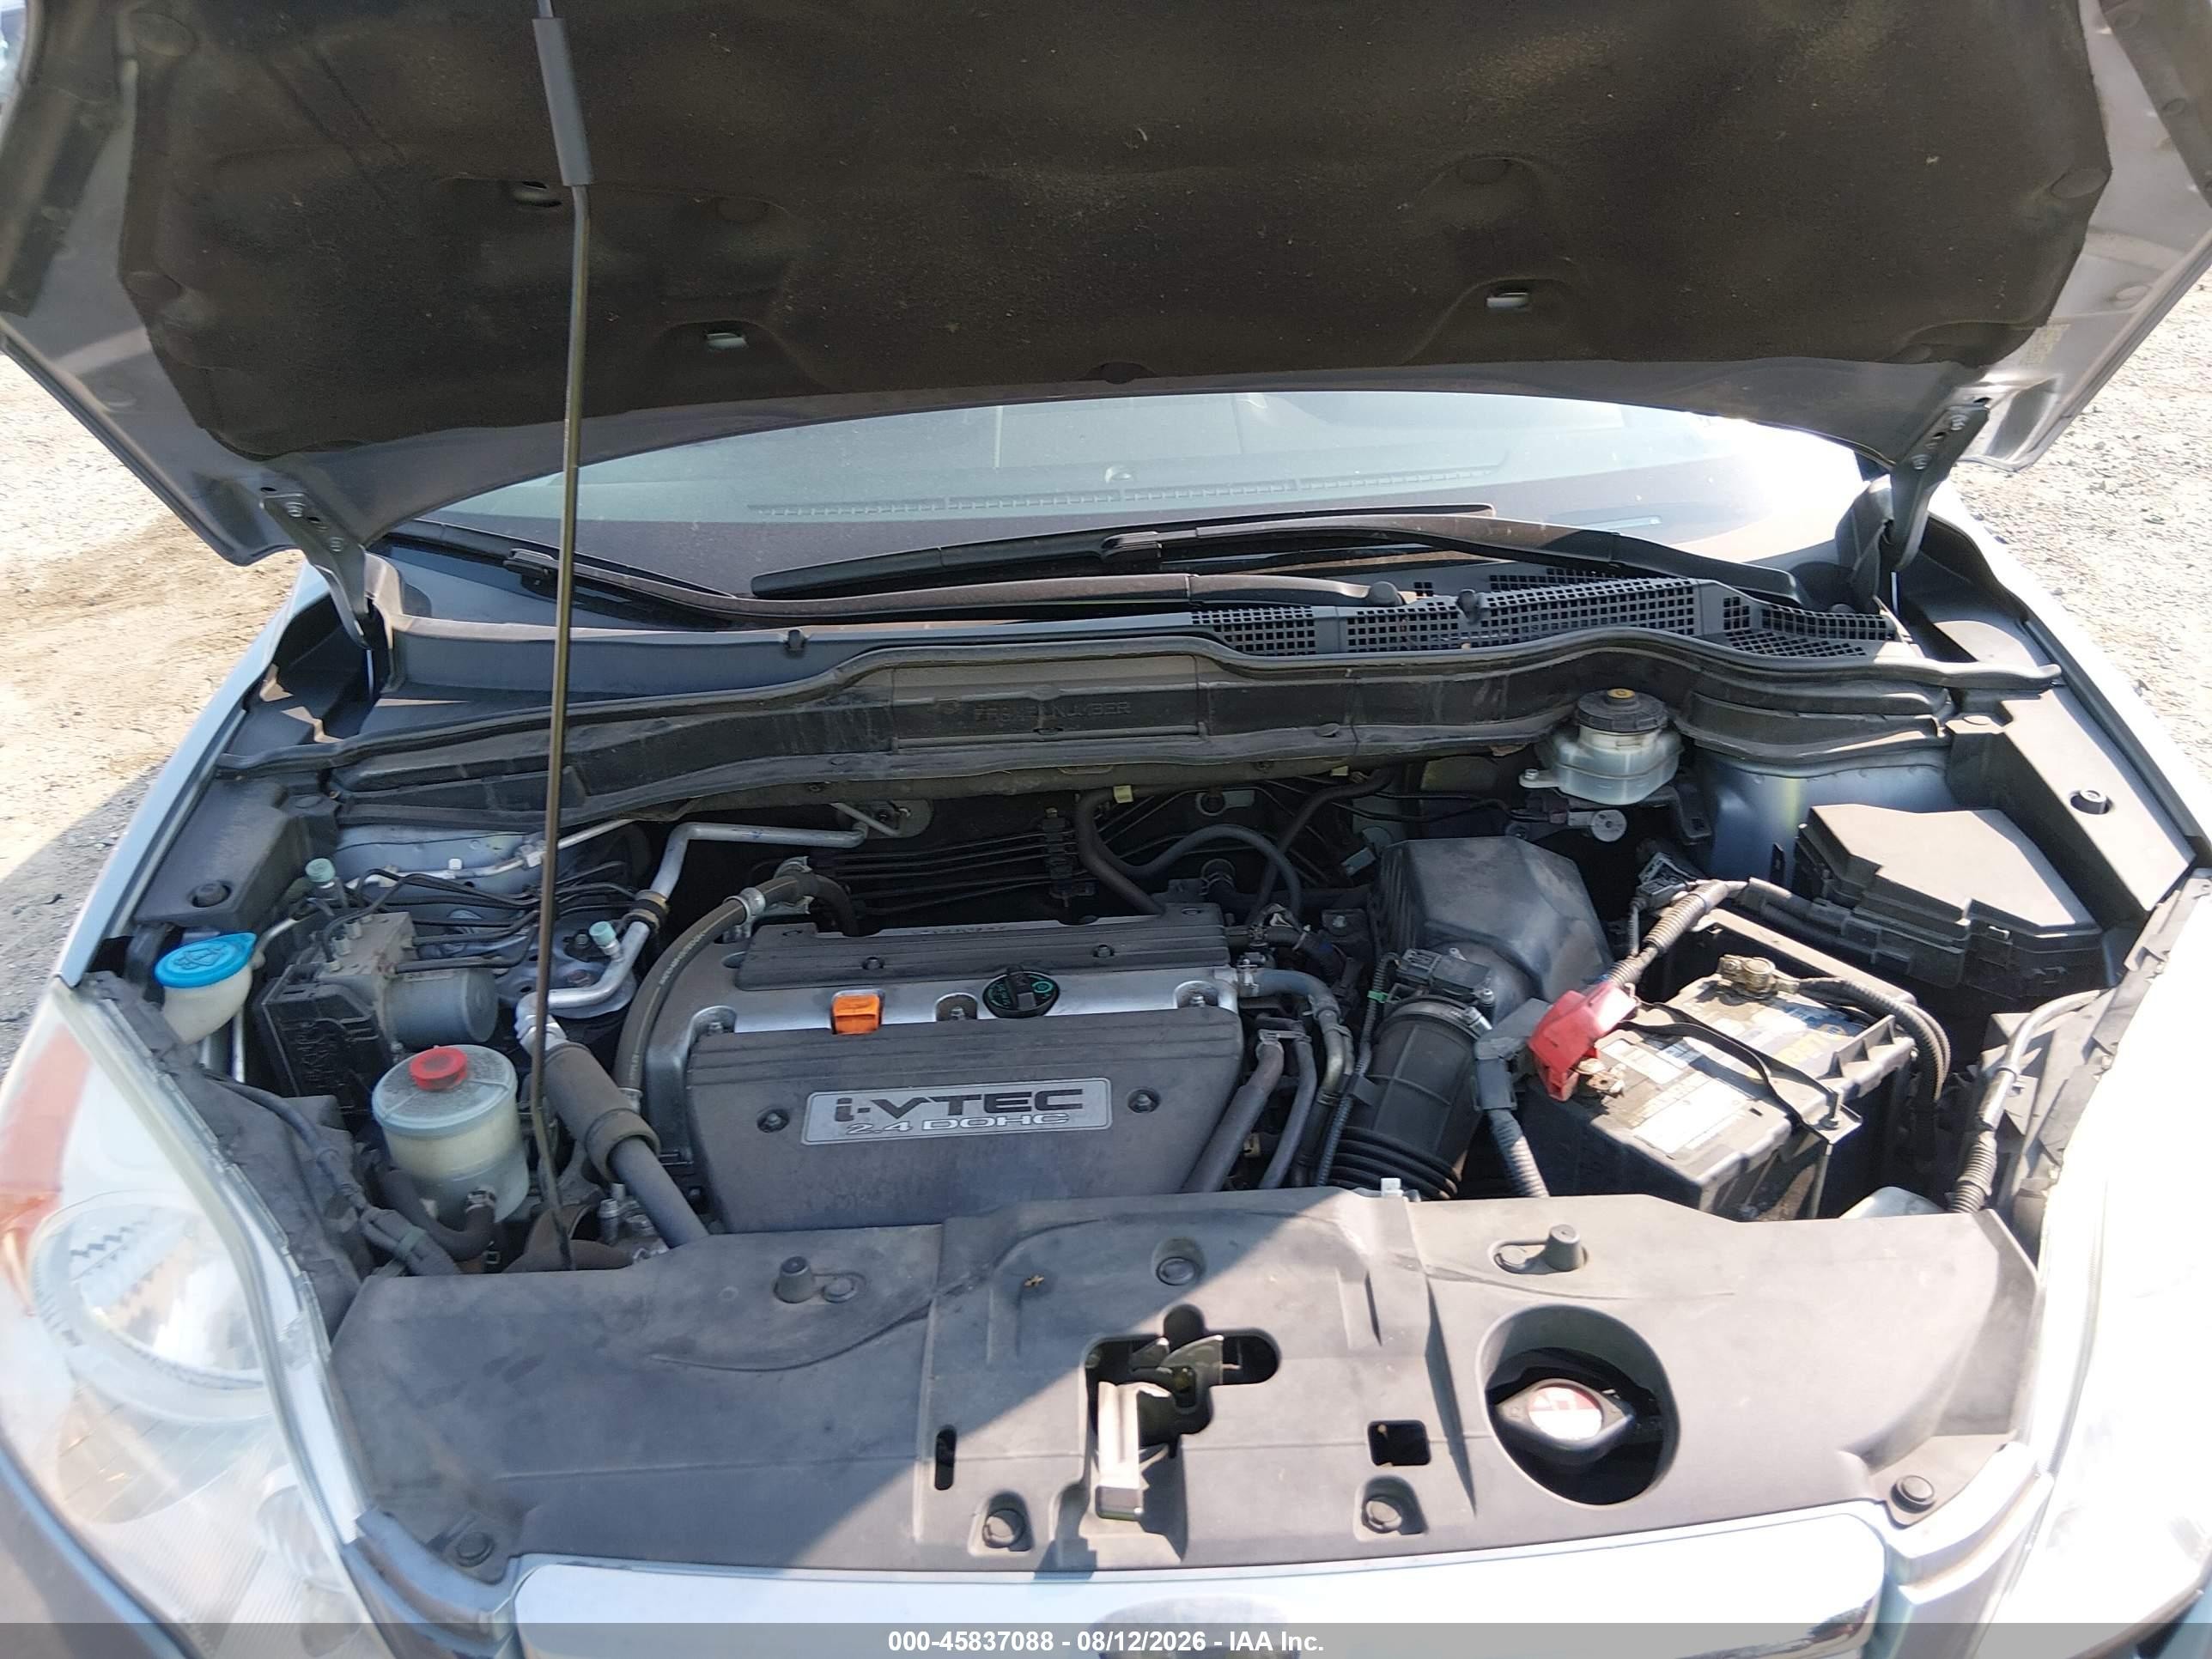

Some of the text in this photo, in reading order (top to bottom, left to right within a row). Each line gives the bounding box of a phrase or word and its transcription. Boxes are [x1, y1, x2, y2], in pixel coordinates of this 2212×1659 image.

[834, 1088, 1084, 1122] i-VTEC
[846, 1112, 1070, 1135] 2.4 DOHC
